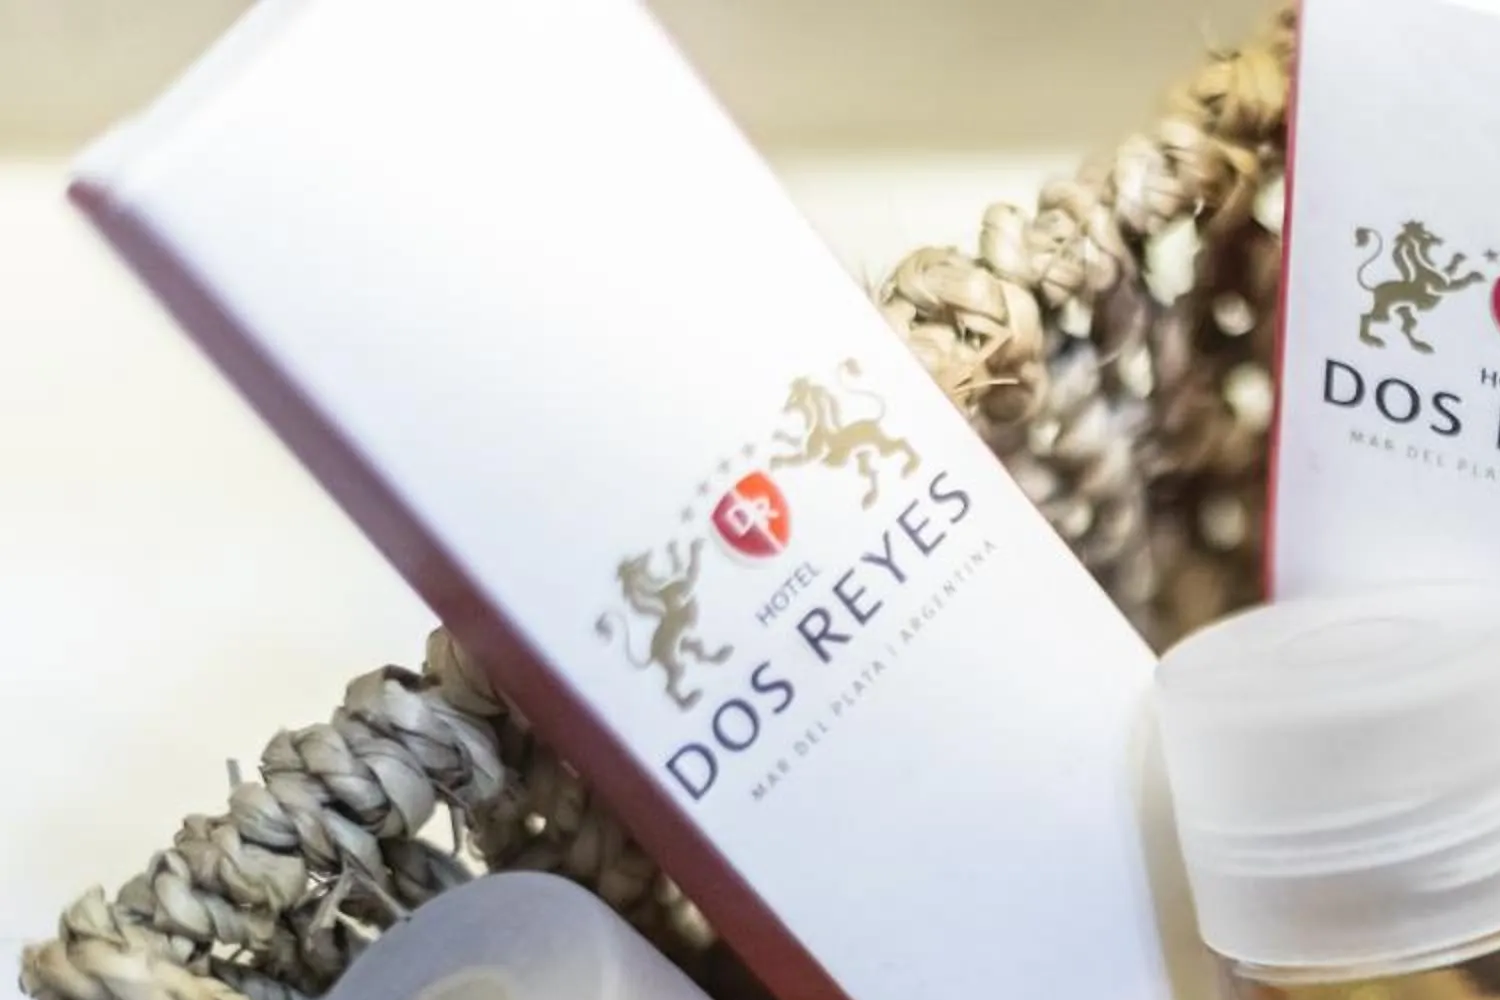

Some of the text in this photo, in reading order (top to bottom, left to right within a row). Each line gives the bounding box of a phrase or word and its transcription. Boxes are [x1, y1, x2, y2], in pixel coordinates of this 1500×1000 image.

[1322, 358, 1463, 437] DOS
[1349, 430, 1395, 452] MAR
[1406, 446, 1445, 468] DEL
[755, 561, 822, 628] HOTEL
[665, 470, 972, 801] DOS REYES
[830, 658, 886, 718] PLATA
